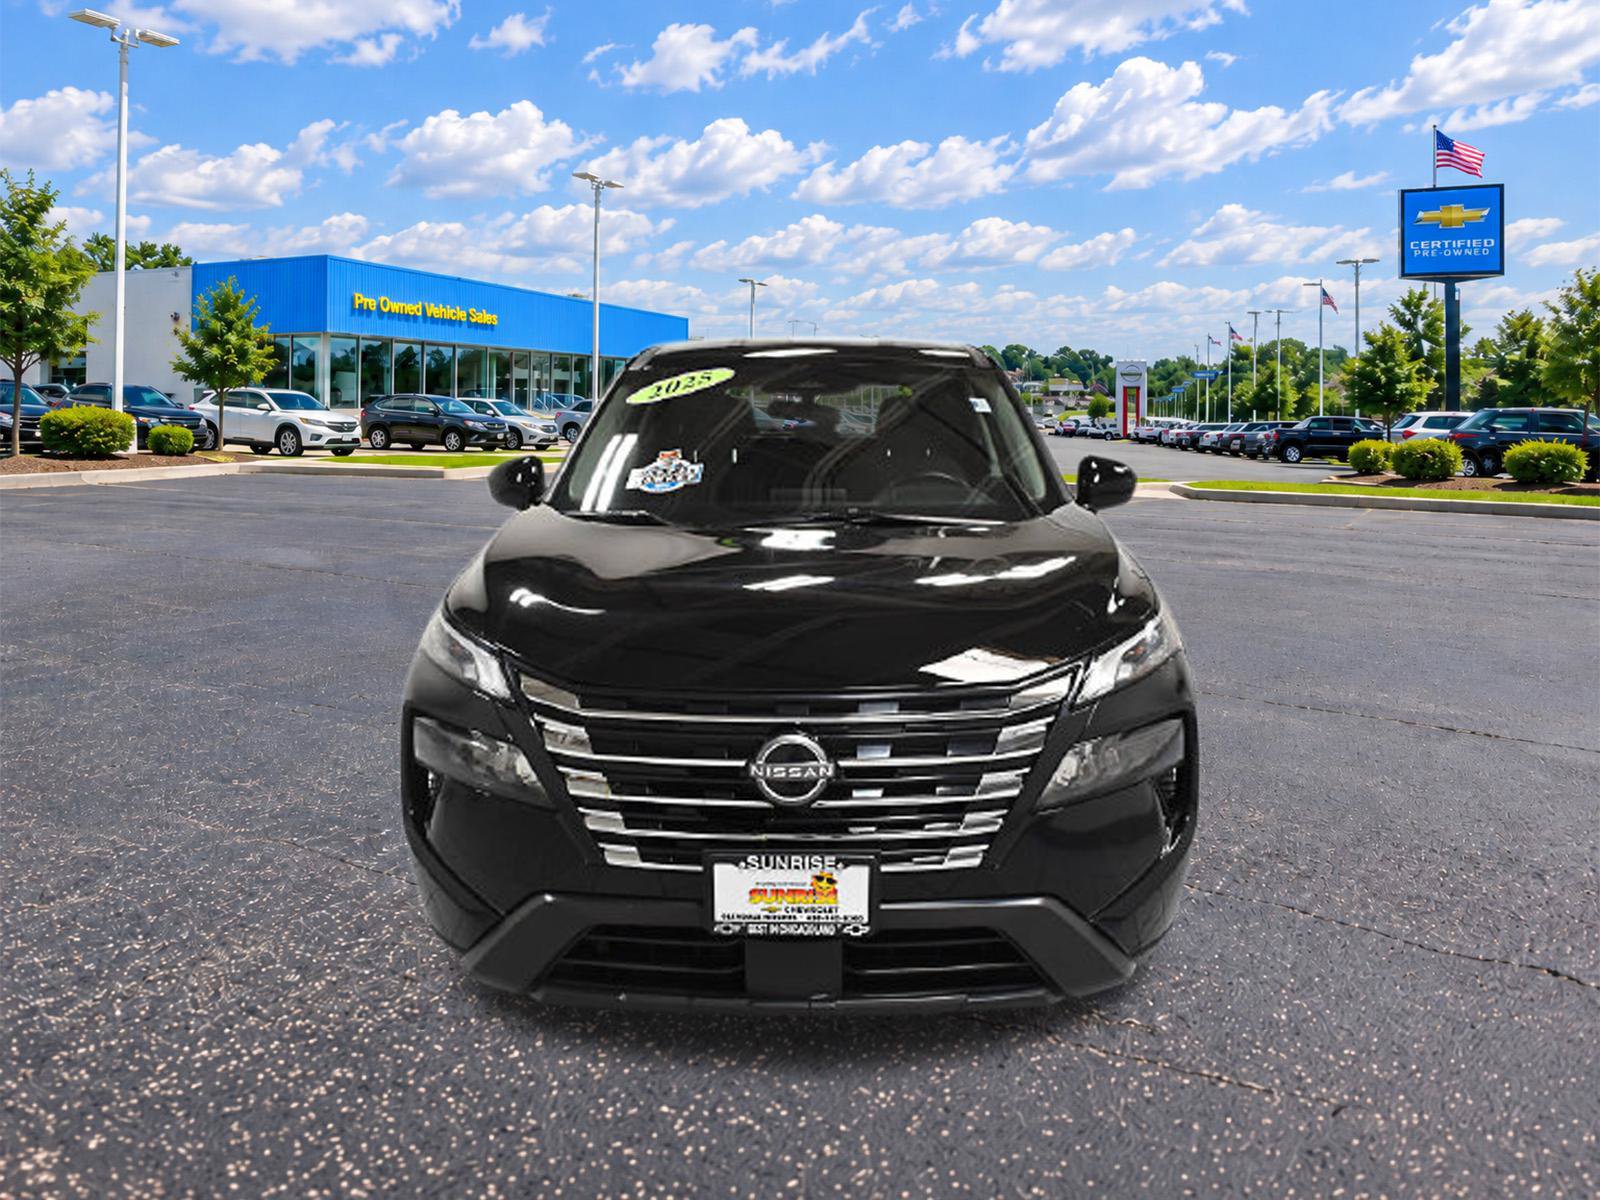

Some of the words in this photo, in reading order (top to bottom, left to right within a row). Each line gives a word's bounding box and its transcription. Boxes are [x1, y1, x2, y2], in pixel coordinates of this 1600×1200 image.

[1410, 239, 1495, 249] CERTIFIED
[1413, 248, 1490, 257] PRE-OWNED
[354, 293, 376, 310] Pre
[379, 296, 422, 316] Owned
[425, 302, 467, 321] Vehicle
[469, 308, 498, 325] Sales
[750, 763, 835, 778] NISSAN
[747, 855, 836, 870] SUNRISE
[748, 888, 839, 905] SUNRISE
[784, 906, 839, 914] CHEVROLET
